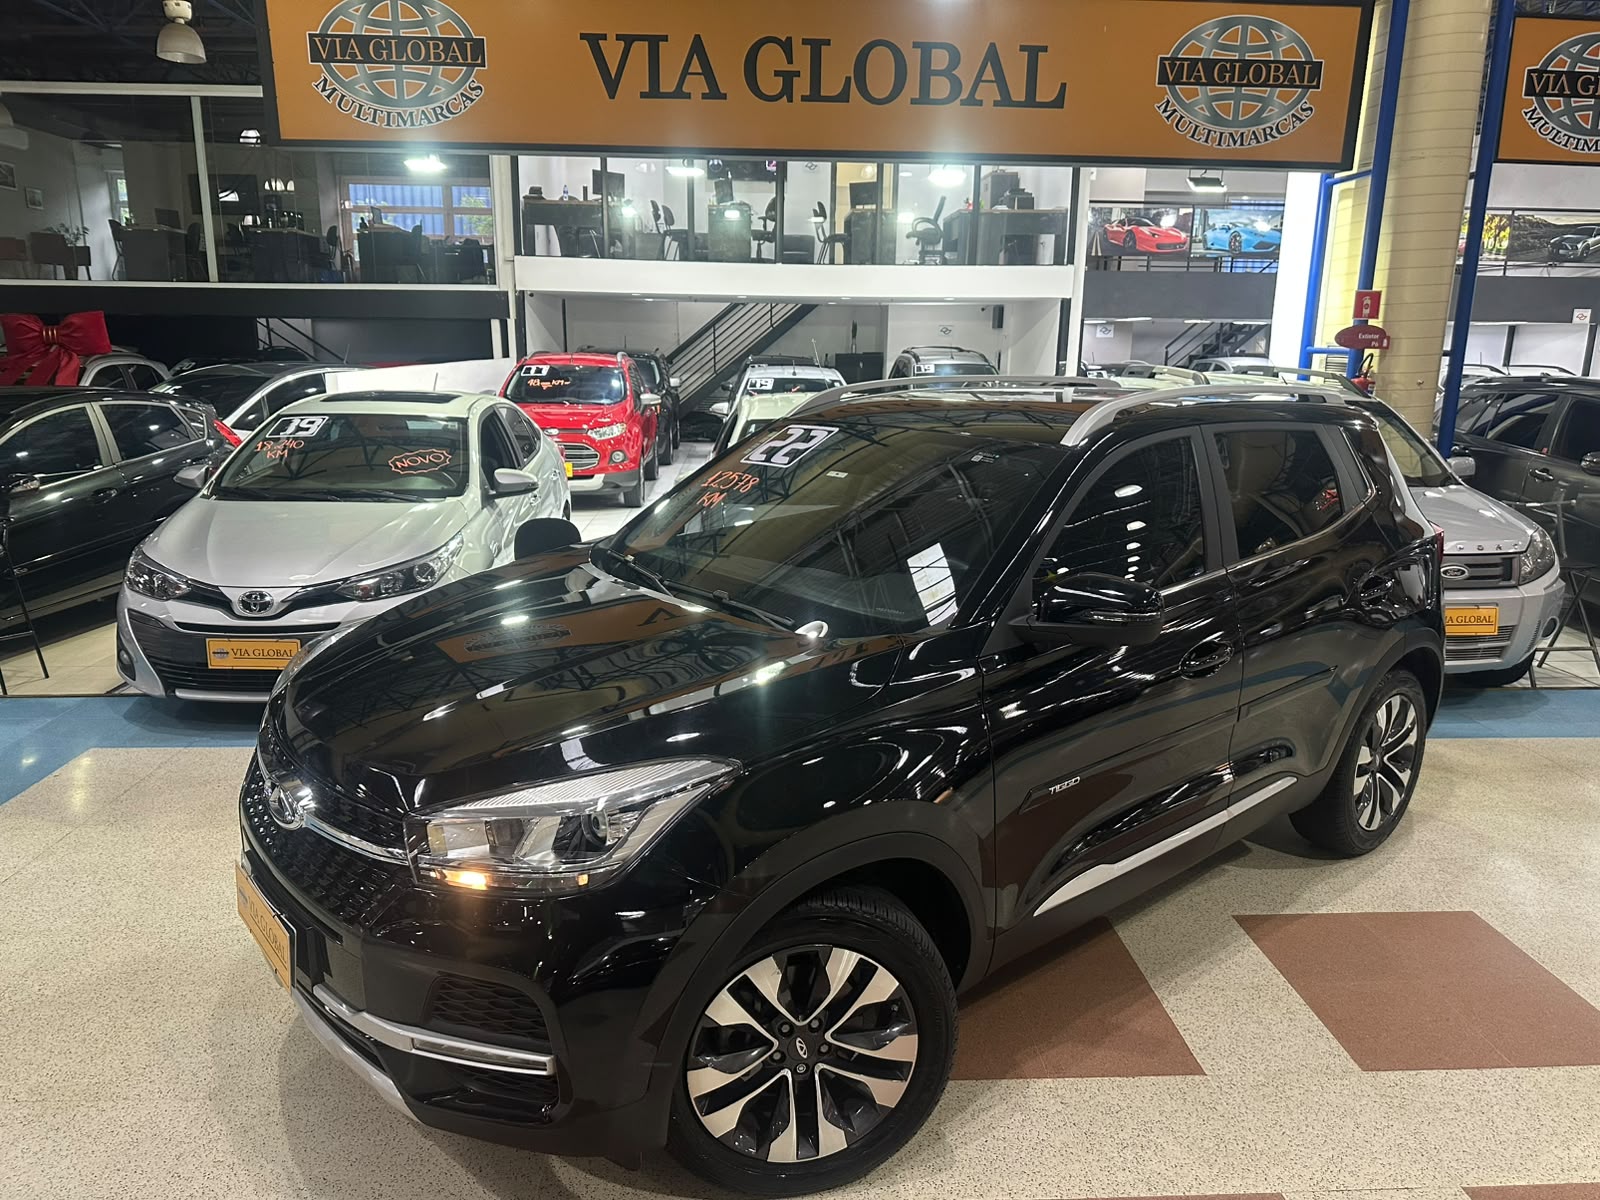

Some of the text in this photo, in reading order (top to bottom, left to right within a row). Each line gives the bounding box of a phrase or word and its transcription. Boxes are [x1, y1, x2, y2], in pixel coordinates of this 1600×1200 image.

[313, 37, 482, 64] VIA GLOBAL
[580, 33, 1067, 109] VIA GLOBAL
[1163, 60, 1317, 86] VIA GLOBAL
[1530, 72, 1571, 95] VIA
[313, 76, 484, 128] MULTIMARCAS
[1156, 97, 1314, 147] MULTIMARCAS
[280, 418, 324, 435] 19
[266, 449, 288, 459] KM
[749, 428, 829, 464] 22
[395, 453, 444, 468] NOVO
[697, 492, 727, 508] KM
[1456, 615, 1493, 624] GLOBAL
[231, 648, 293, 657] VIA GLOBAL
[1048, 776, 1081, 795] TIGGO
[260, 914, 286, 963] GLOBAL
